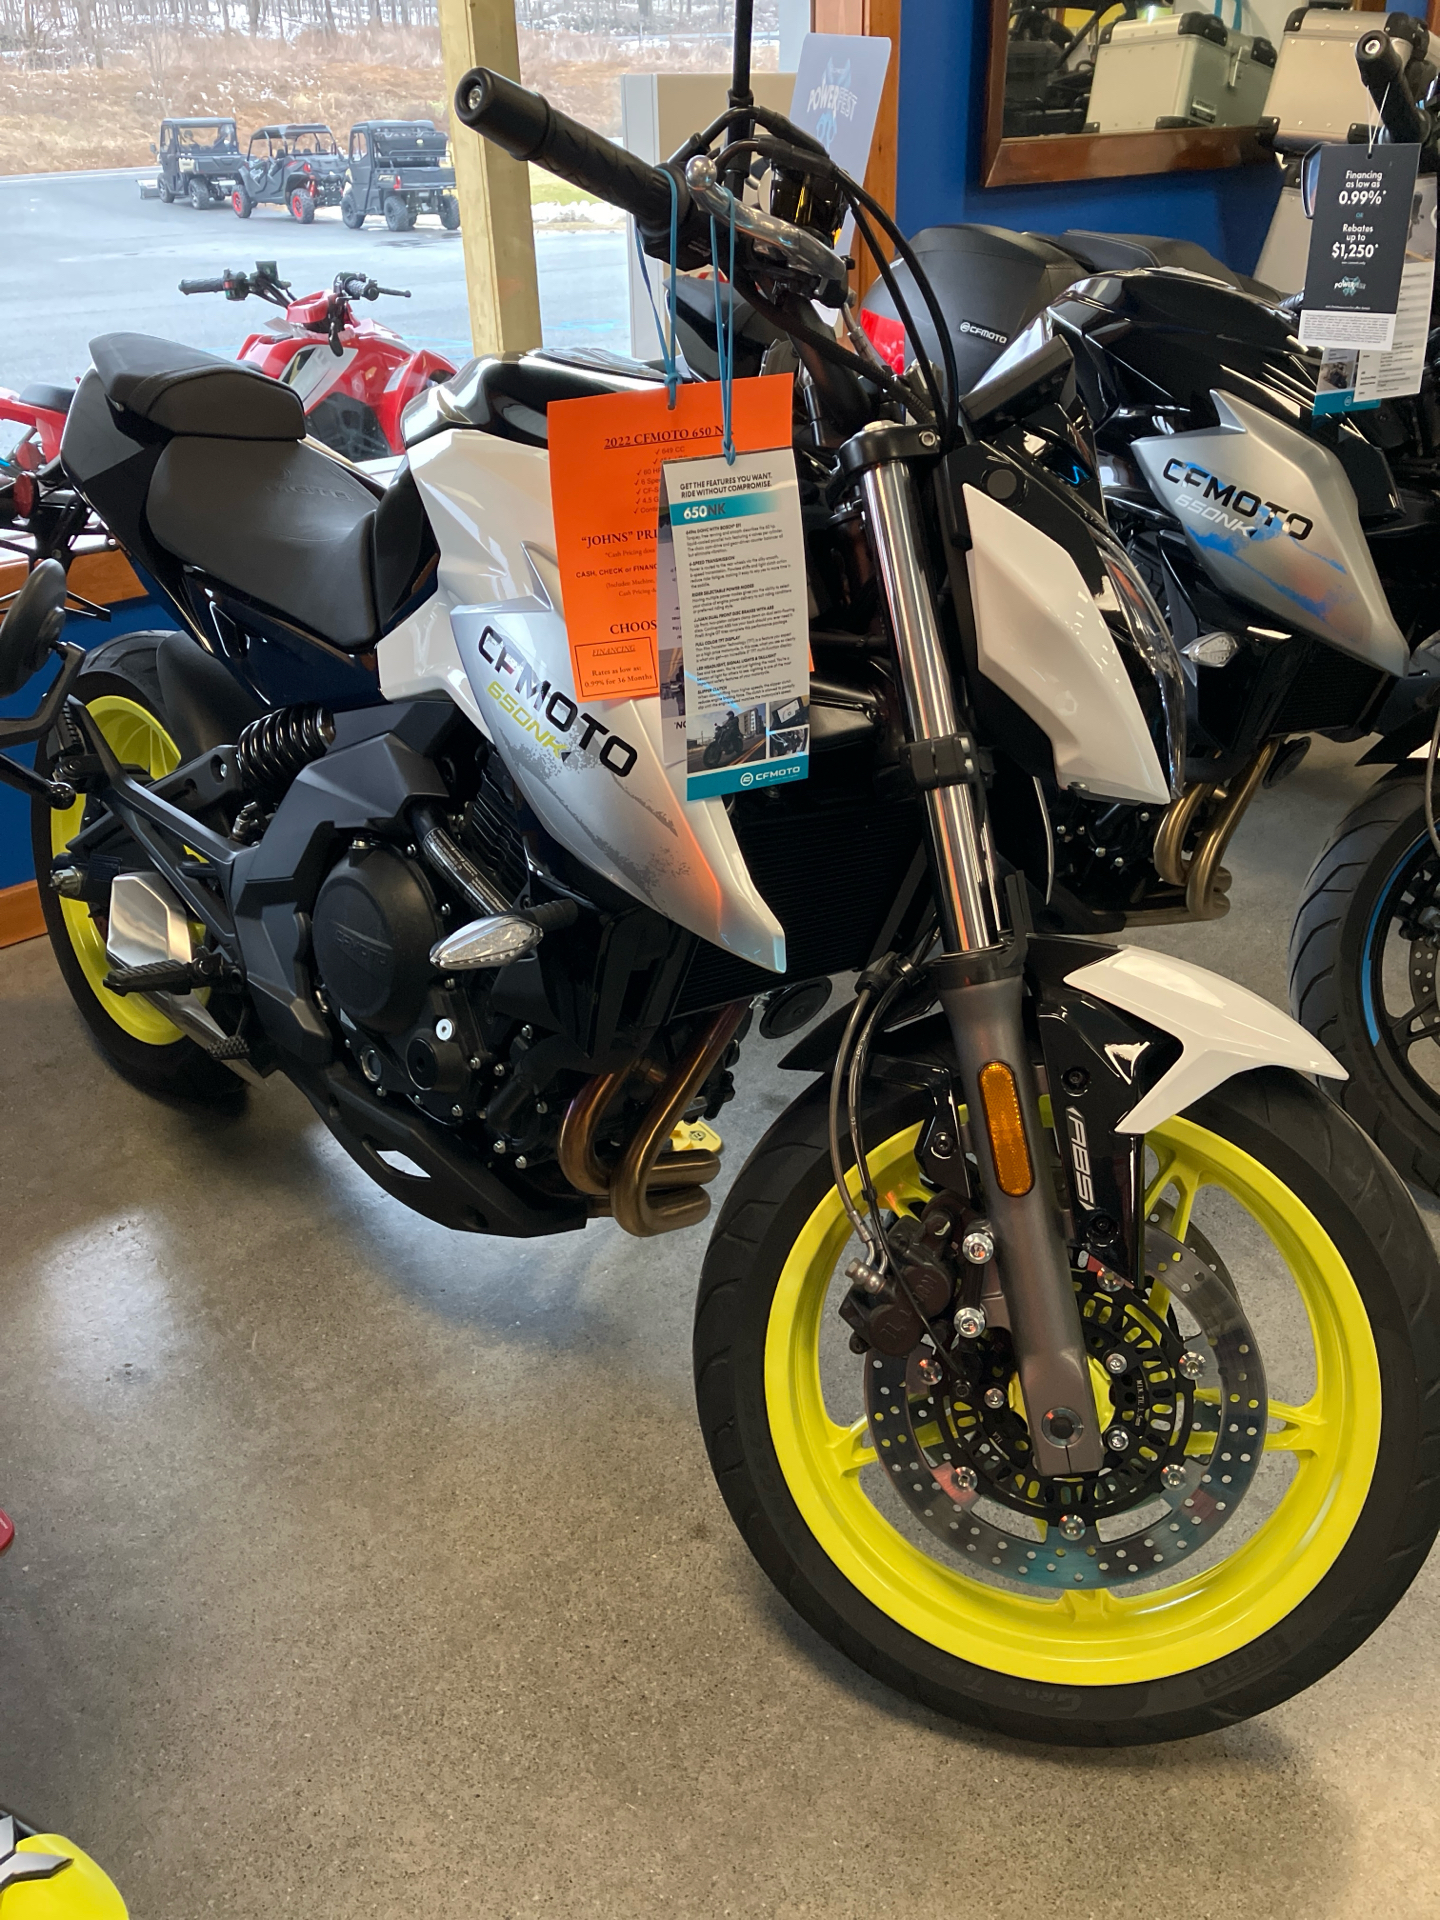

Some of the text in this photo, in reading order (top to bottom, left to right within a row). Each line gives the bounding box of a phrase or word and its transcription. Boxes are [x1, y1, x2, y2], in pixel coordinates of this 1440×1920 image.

[1345, 170, 1382, 181] Financing
[1356, 179, 1370, 188] low
[1342, 223, 1374, 232] Rebates
[1346, 233, 1366, 243] up to
[968, 324, 1008, 344] CFMOTO
[604, 436, 632, 448] 2022
[633, 429, 689, 444] CFMOTO
[692, 426, 712, 438] 650
[680, 472, 773, 491] GET THE FEATURES YOU WANT.
[681, 480, 773, 498] RIDE WITHOUT COMPROMISE.
[1162, 457, 1314, 541] CFMOTO
[683, 502, 726, 520] 650NK
[1174, 493, 1256, 539] 650NK
[622, 549, 642, 557] Pricing
[576, 570, 597, 578] CASH,
[598, 567, 623, 576] CHECK
[591, 667, 611, 677] Rates
[619, 666, 630, 674] low
[584, 679, 605, 688] 0.99%
[606, 678, 616, 686] for
[627, 674, 653, 682] Months
[477, 624, 638, 778] CFMOTO
[487, 680, 570, 761] 650NK
[755, 766, 800, 781] CFMOTO
[1067, 1114, 1095, 1205] ABS
